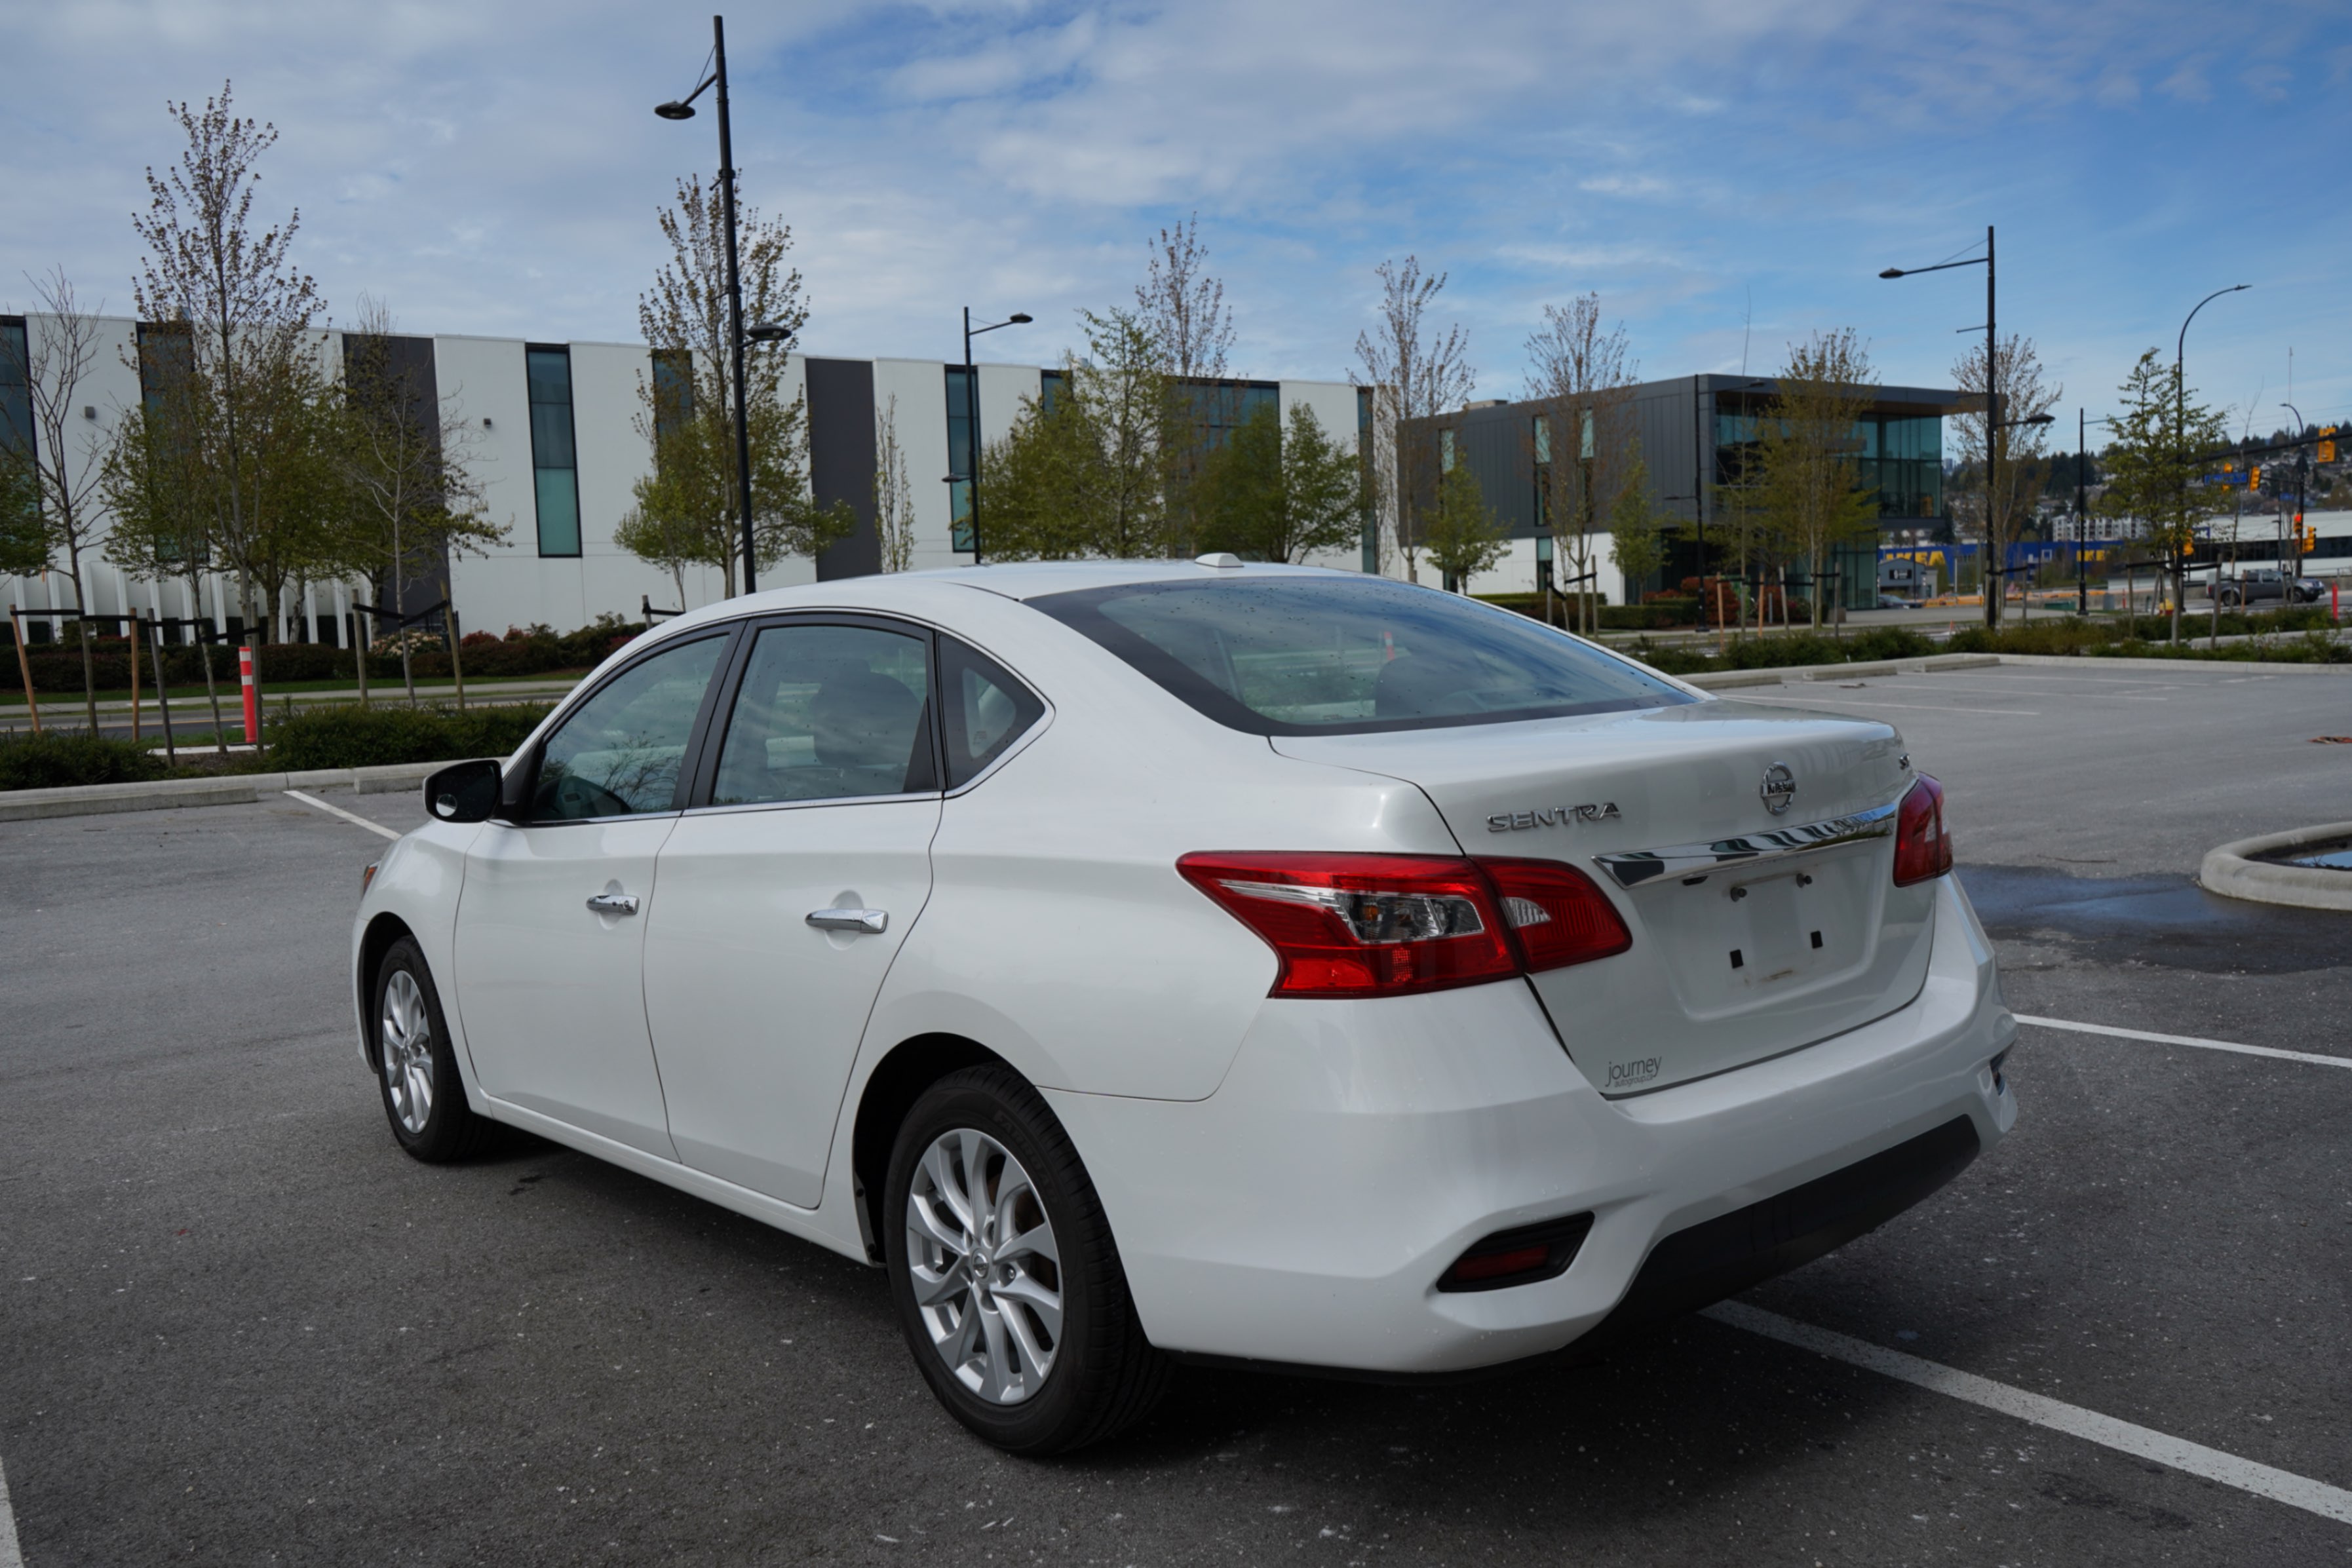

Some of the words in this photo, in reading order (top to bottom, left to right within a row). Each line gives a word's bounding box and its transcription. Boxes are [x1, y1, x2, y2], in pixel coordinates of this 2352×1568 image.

[2076, 550, 2108, 562] IKE
[1487, 802, 1621, 833] SENTRA
[1605, 1056, 1662, 1087] journey
